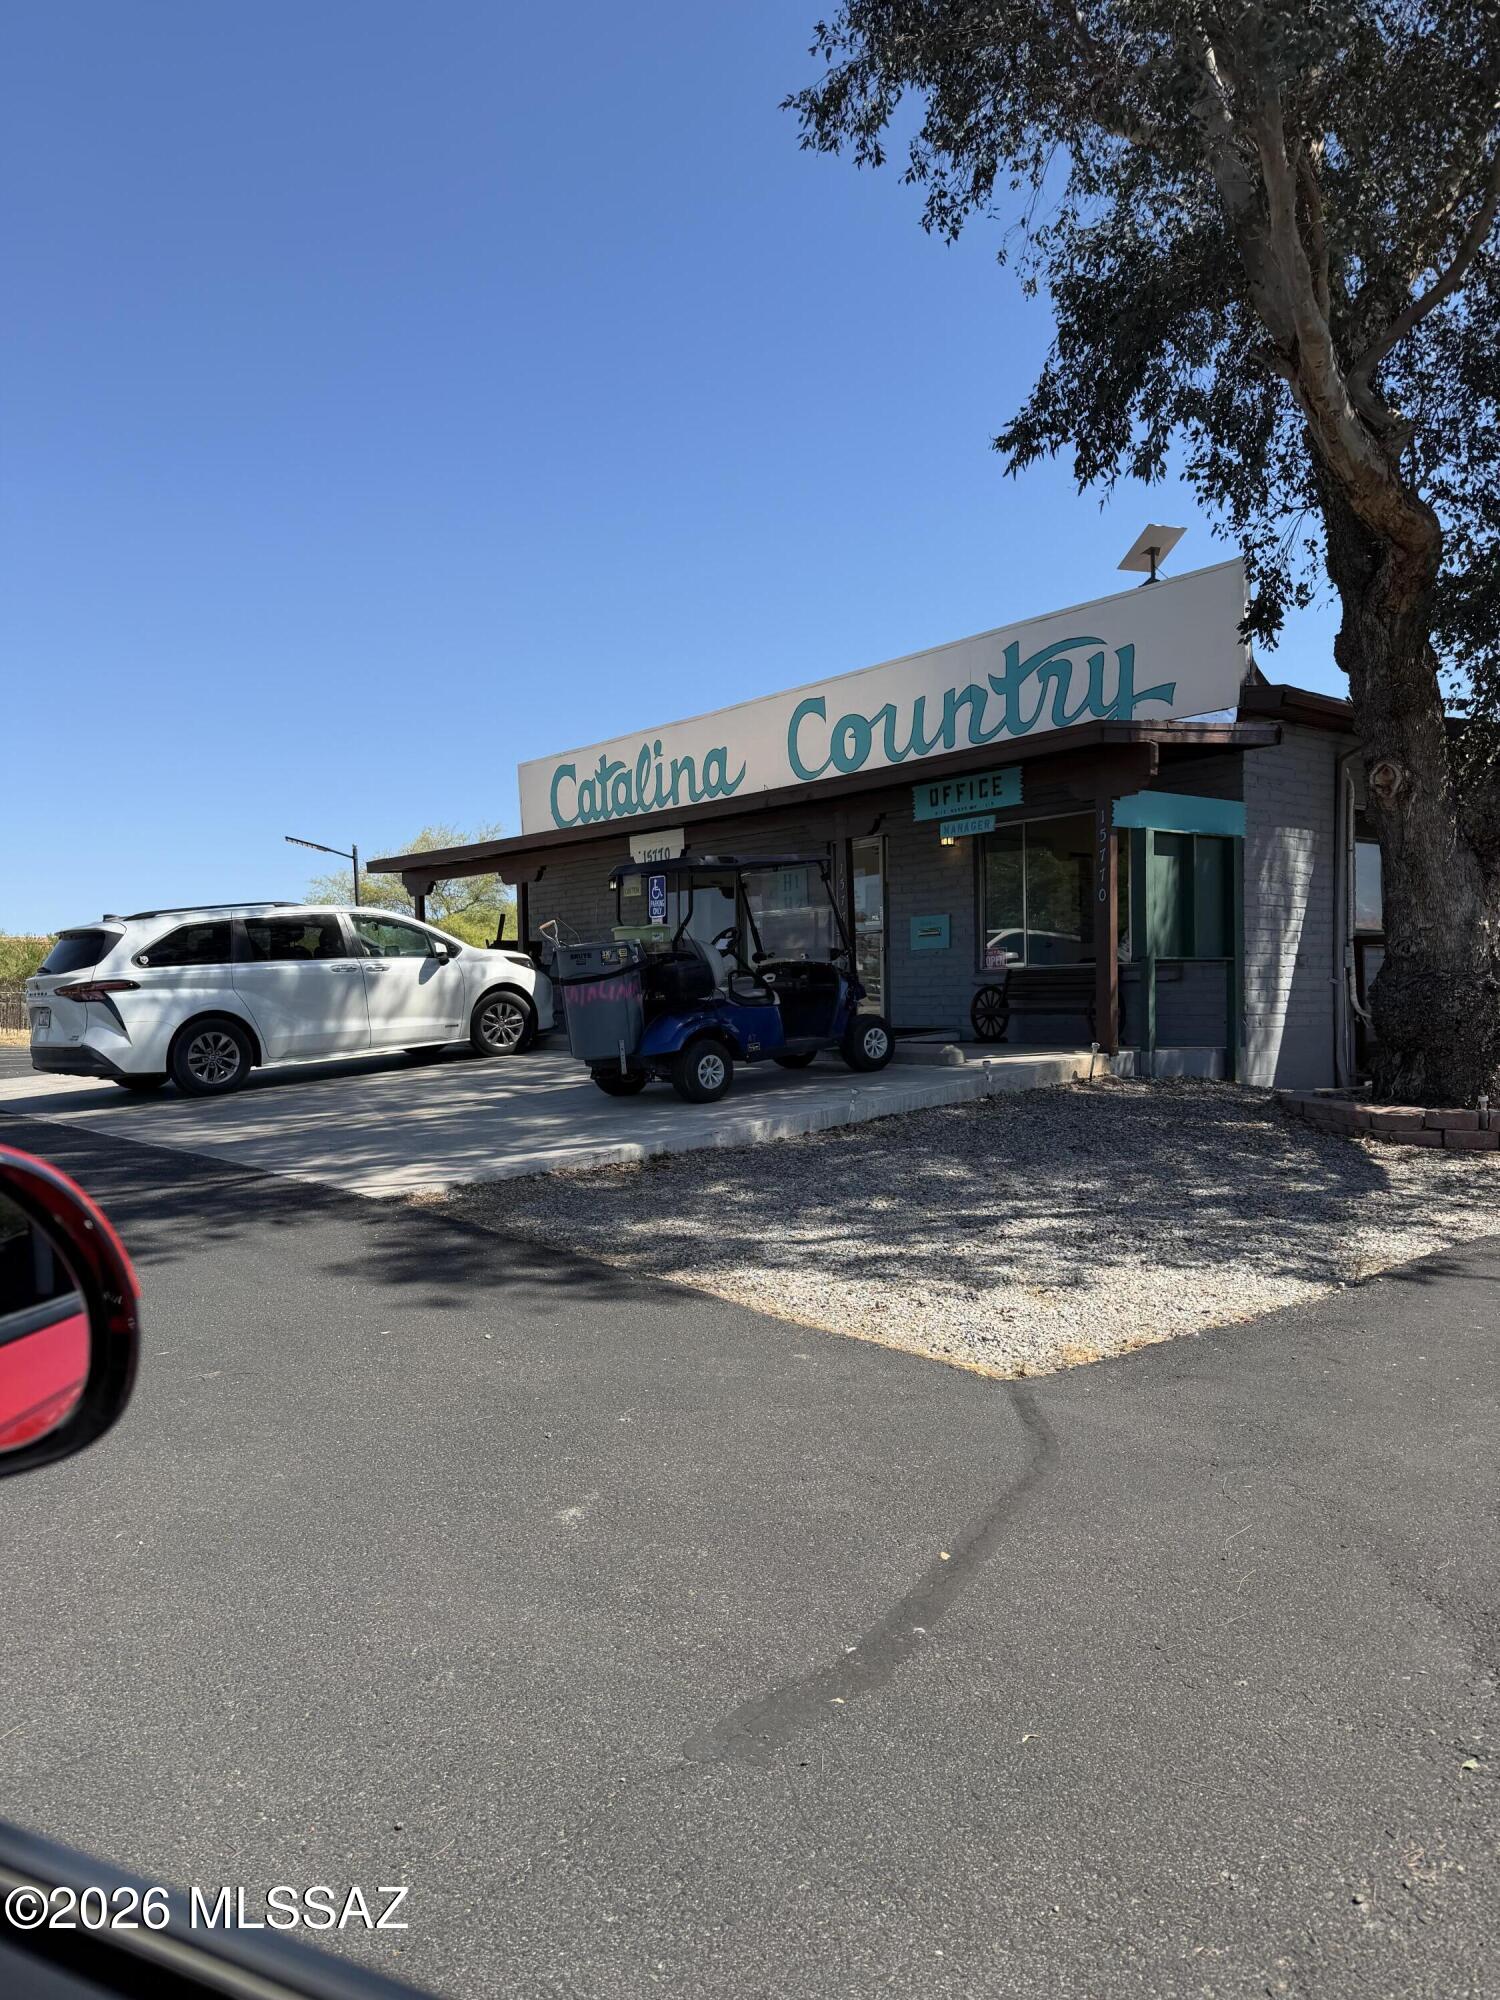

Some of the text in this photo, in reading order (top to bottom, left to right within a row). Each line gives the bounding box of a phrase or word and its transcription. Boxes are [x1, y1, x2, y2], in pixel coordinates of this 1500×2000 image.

[550, 636, 1176, 829] Catalina Country
[929, 775, 1003, 808] OFFICE
[943, 819, 991, 836] MANAGER
[643, 847, 671, 864] 15770
[1098, 809, 1107, 902] 15770
[650, 899, 665, 907] PARKING
